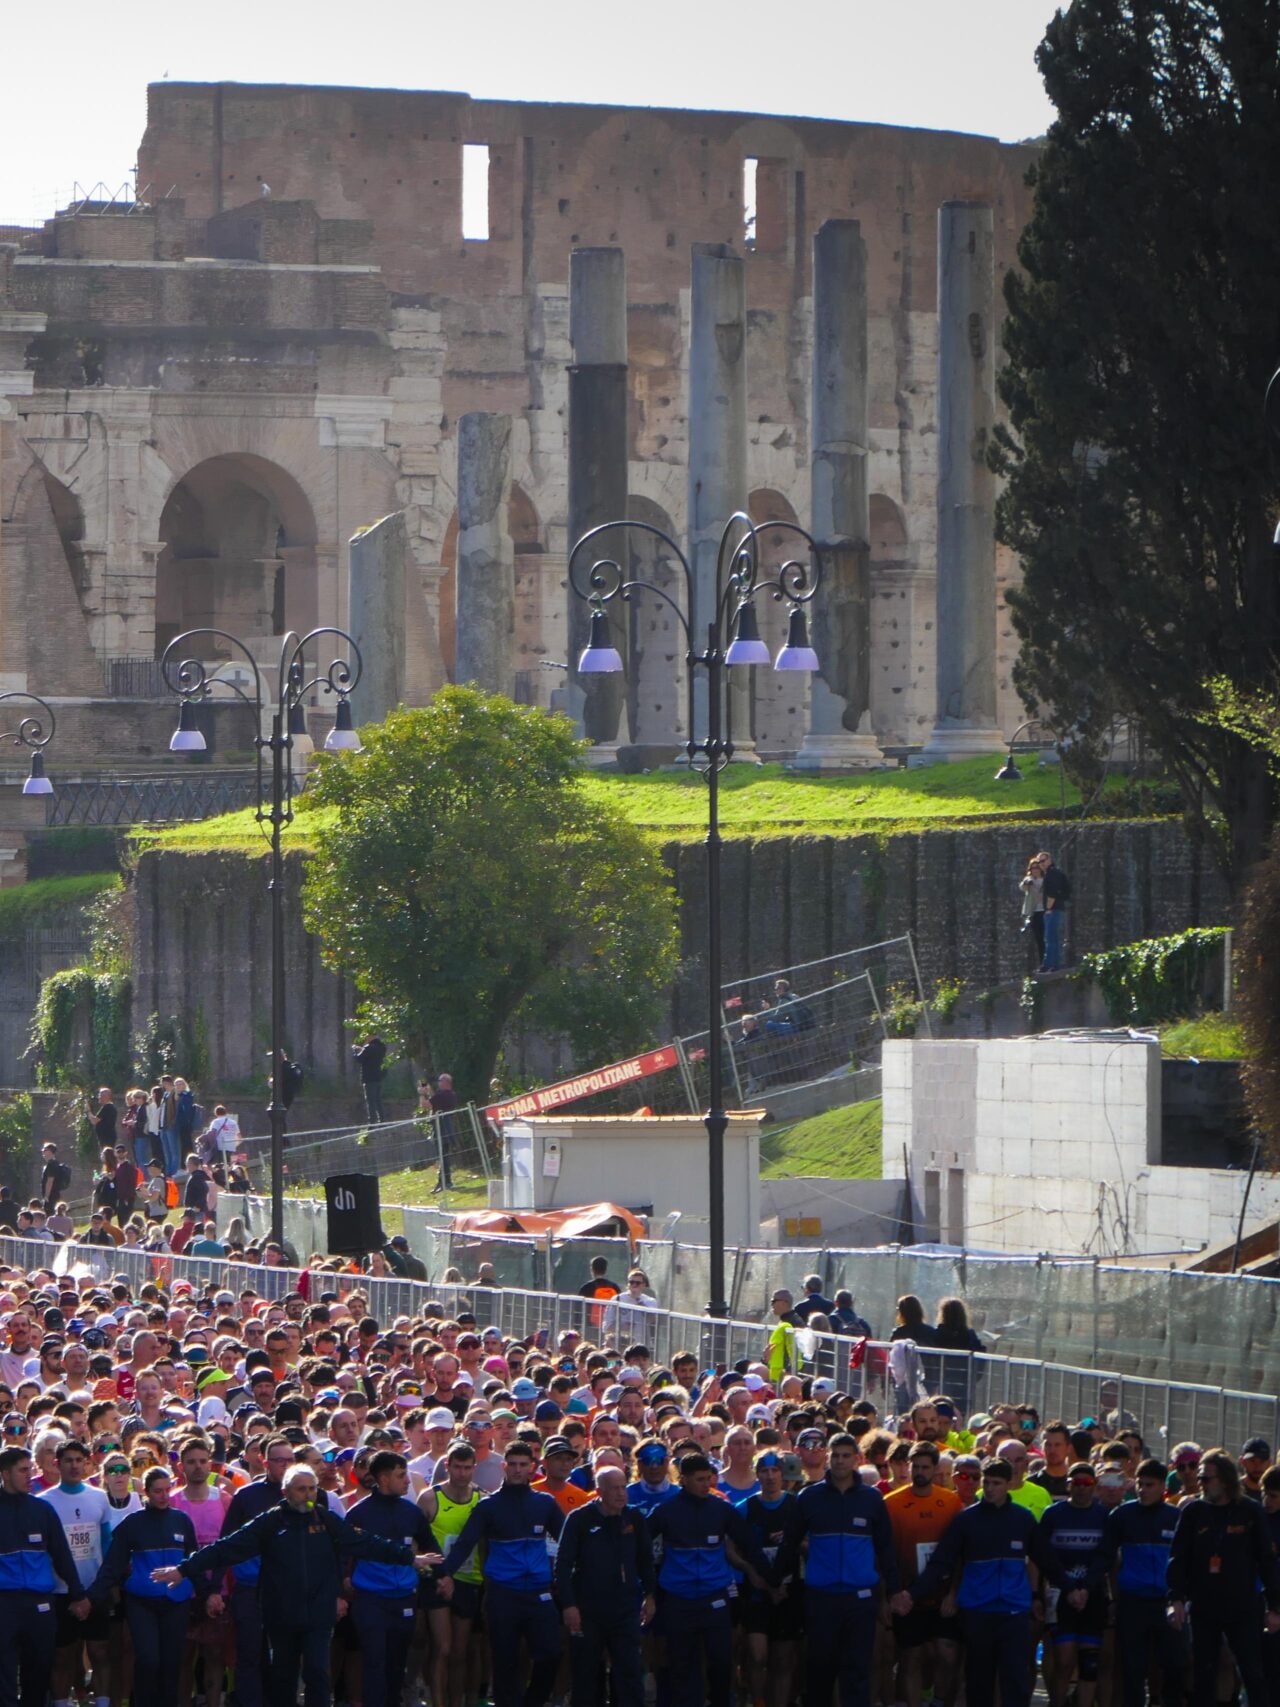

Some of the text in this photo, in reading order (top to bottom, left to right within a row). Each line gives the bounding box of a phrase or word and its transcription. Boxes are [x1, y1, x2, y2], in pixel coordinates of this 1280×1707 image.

[498, 1060, 642, 1118] ROMA METROPOLITANE
[334, 1187, 356, 1211] dn
